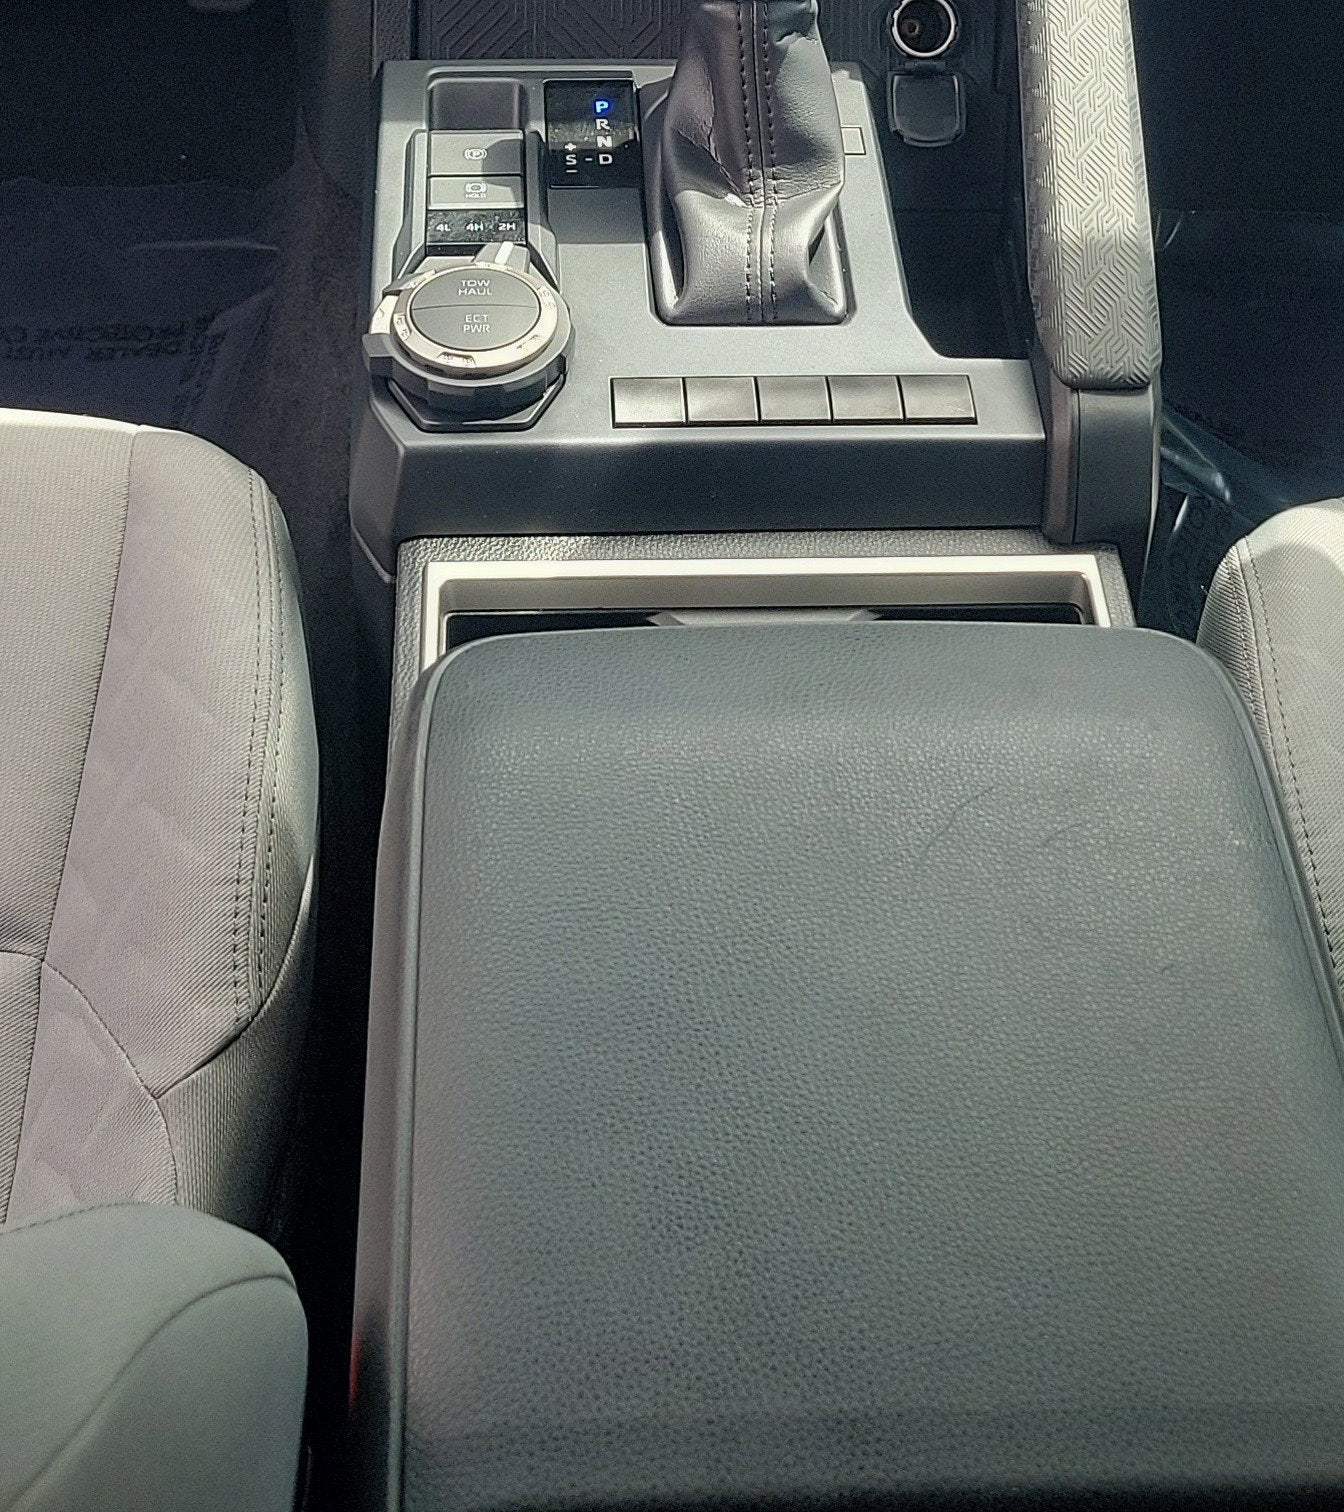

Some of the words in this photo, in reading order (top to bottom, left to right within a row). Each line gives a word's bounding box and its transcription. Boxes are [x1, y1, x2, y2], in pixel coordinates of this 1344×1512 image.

[595, 100, 610, 113] P
[596, 118, 611, 130] R
[596, 135, 613, 148] N
[565, 154, 577, 165] S
[599, 154, 613, 165] D
[436, 223, 451, 232] 4L
[466, 222, 484, 231] 4H
[498, 222, 516, 231] 2H
[460, 279, 491, 287] TOW
[458, 288, 493, 296] HAUL
[465, 314, 489, 323] ECT
[463, 324, 491, 333] PWR
